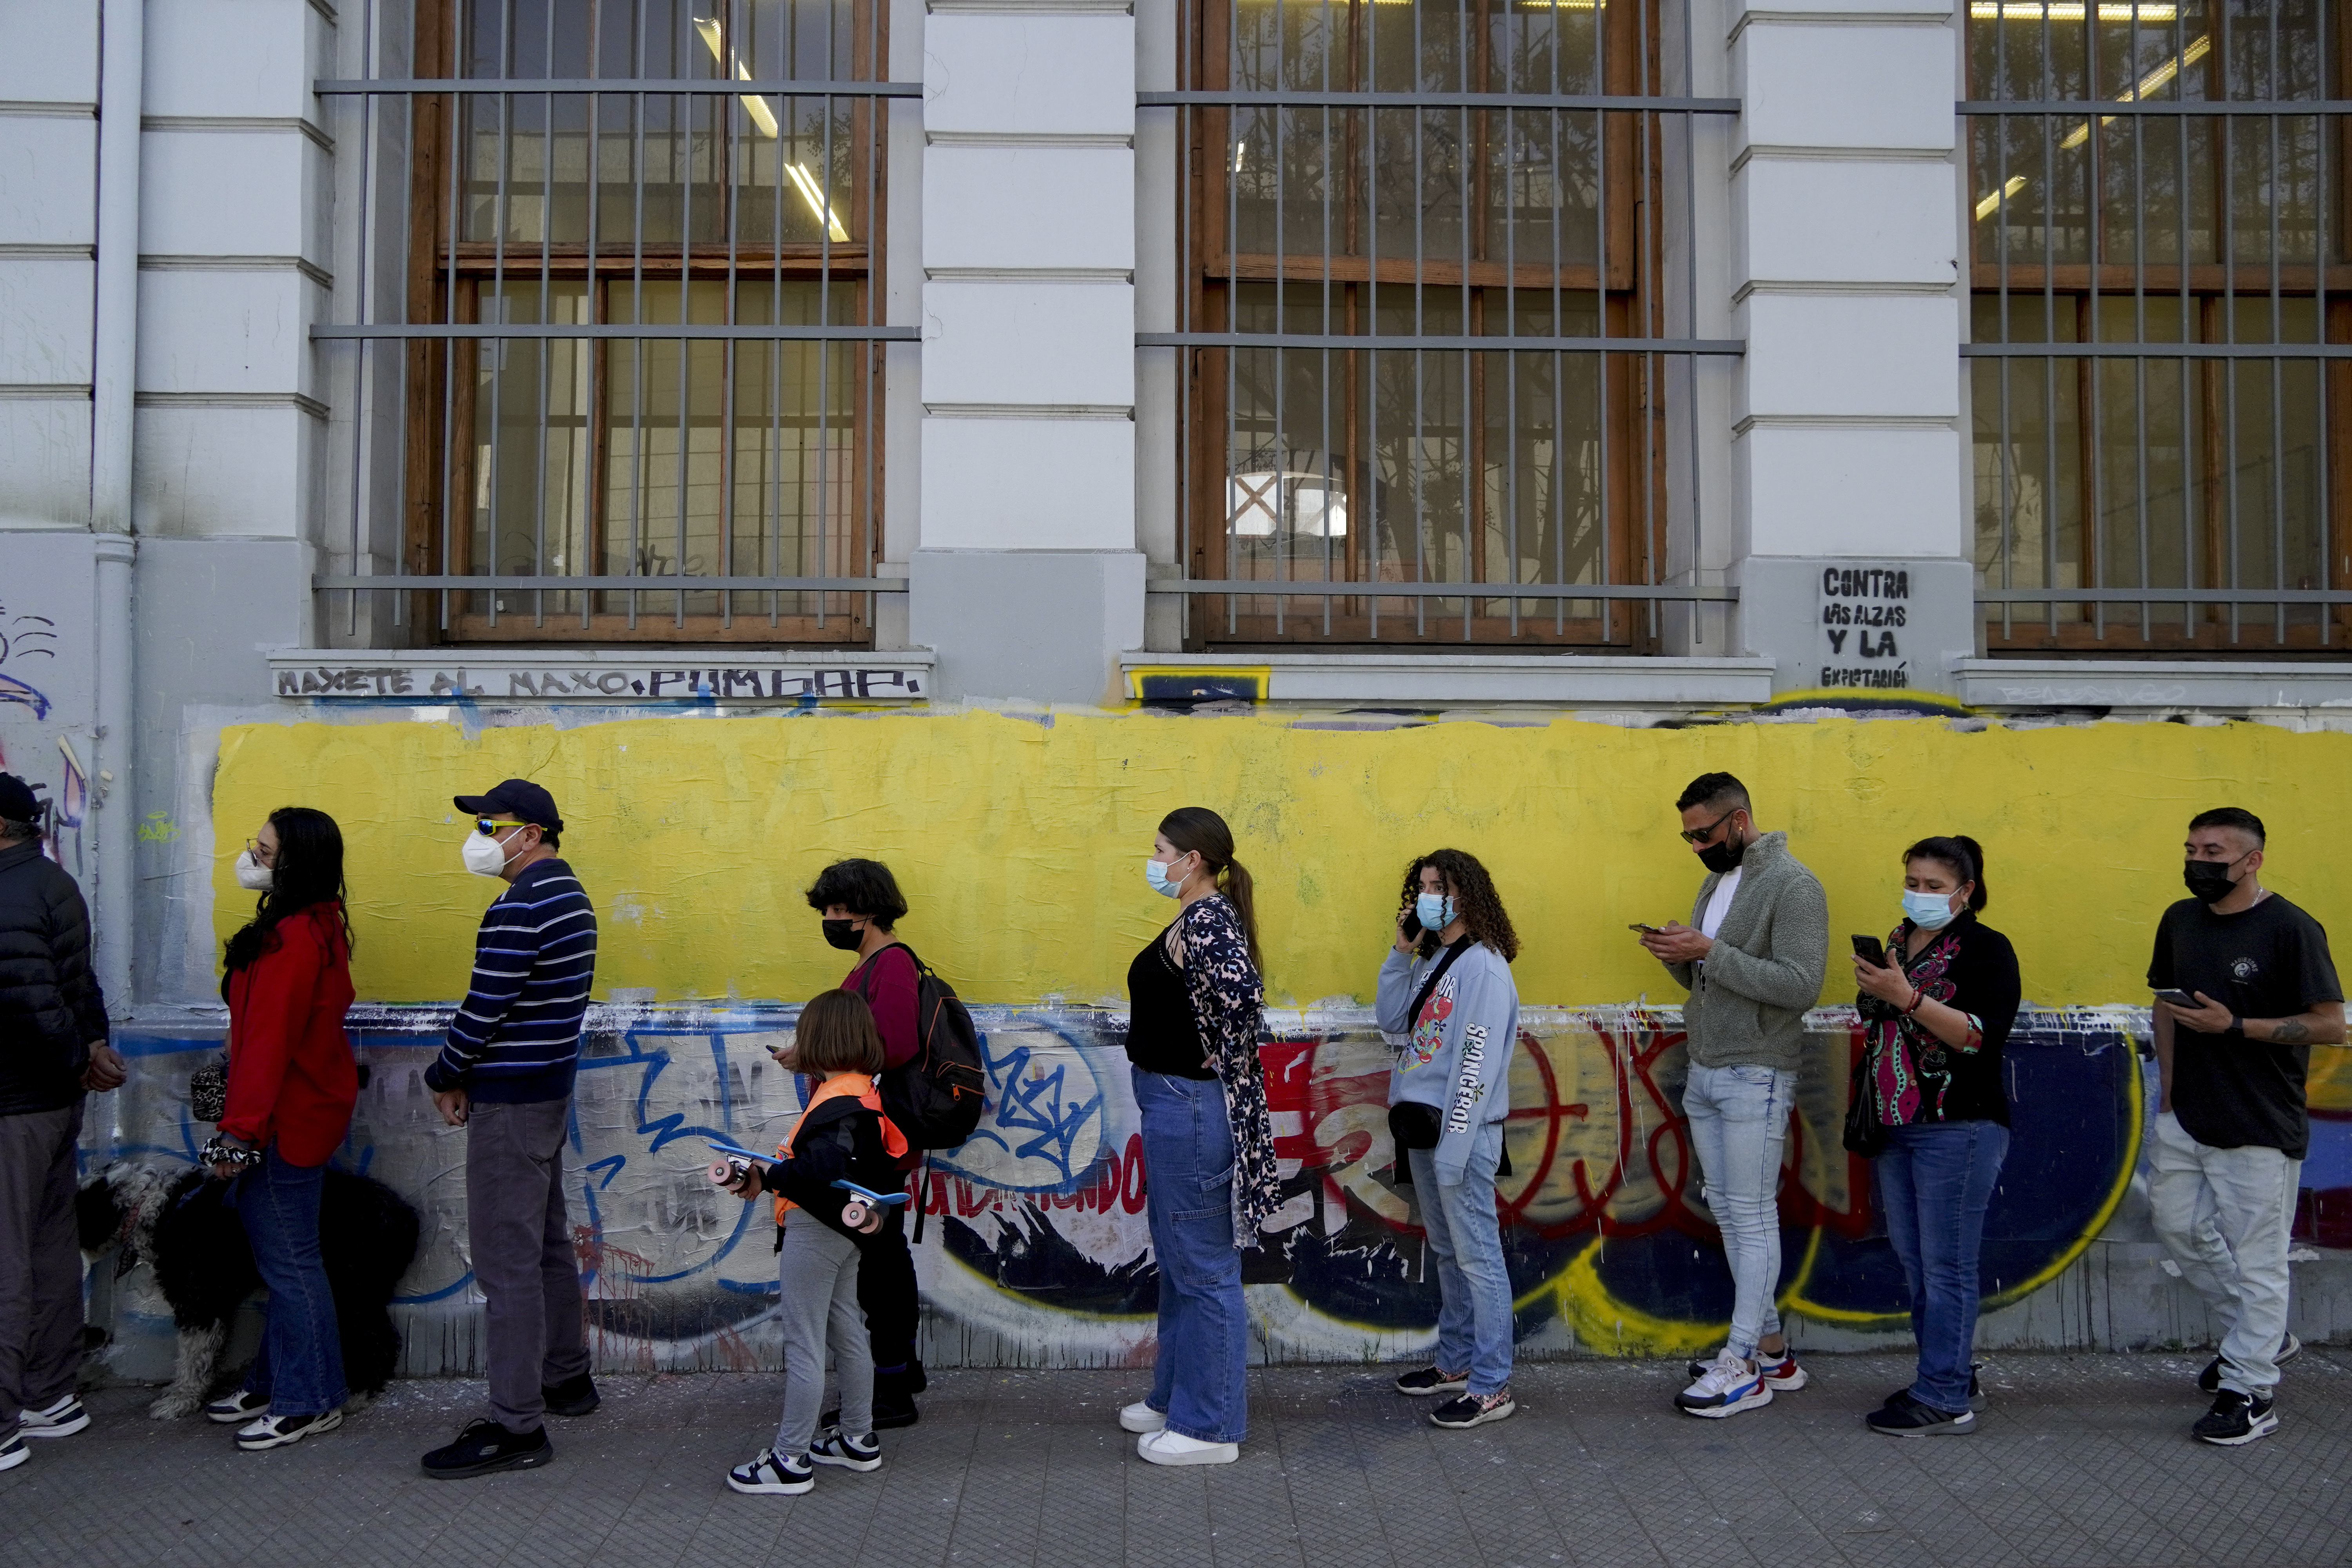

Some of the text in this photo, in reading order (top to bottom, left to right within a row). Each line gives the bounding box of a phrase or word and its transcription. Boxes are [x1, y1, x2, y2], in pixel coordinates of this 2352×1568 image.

[1823, 567, 1908, 599] CONTRA
[1854, 605, 1906, 627] ALZAS
[1827, 629, 1896, 657] Y LA
[1446, 1022, 1489, 1134] SPONGEBOB
